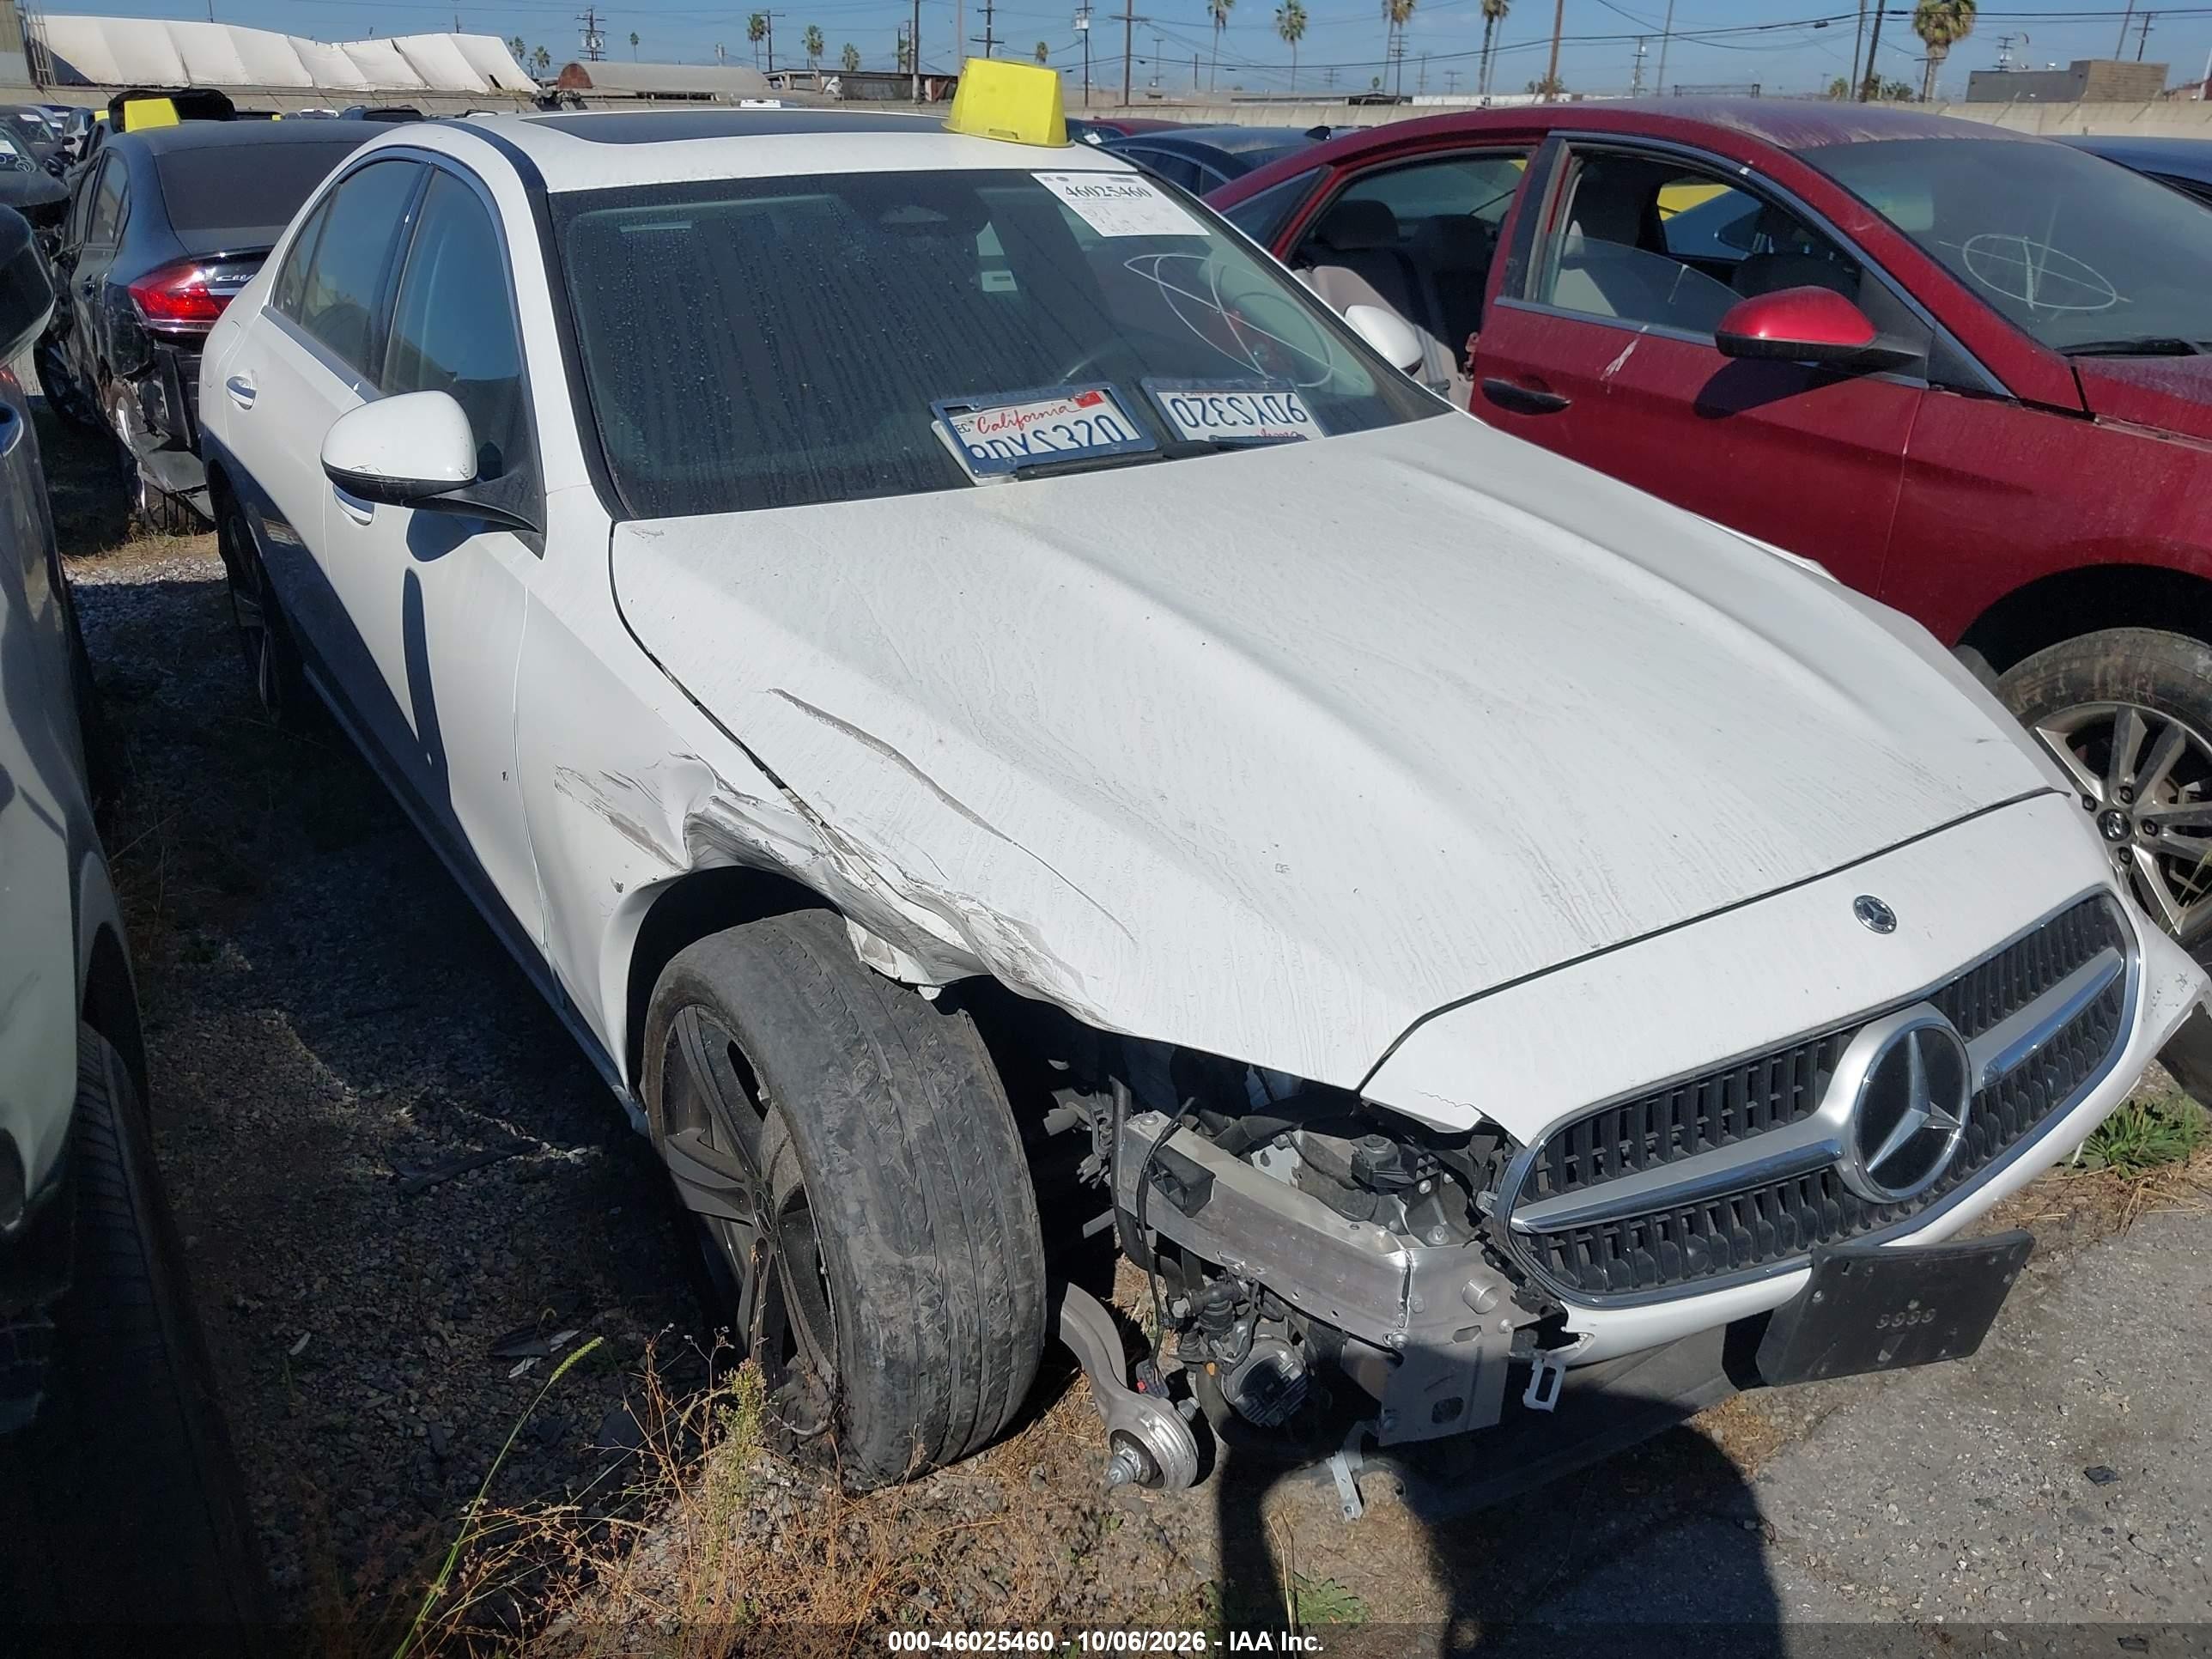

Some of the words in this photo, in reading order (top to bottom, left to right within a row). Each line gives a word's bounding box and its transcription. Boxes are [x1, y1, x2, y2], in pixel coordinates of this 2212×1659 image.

[1065, 185, 1152, 198] 46025460
[976, 404, 1080, 434] California
[1170, 394, 1307, 428] 9DYS320
